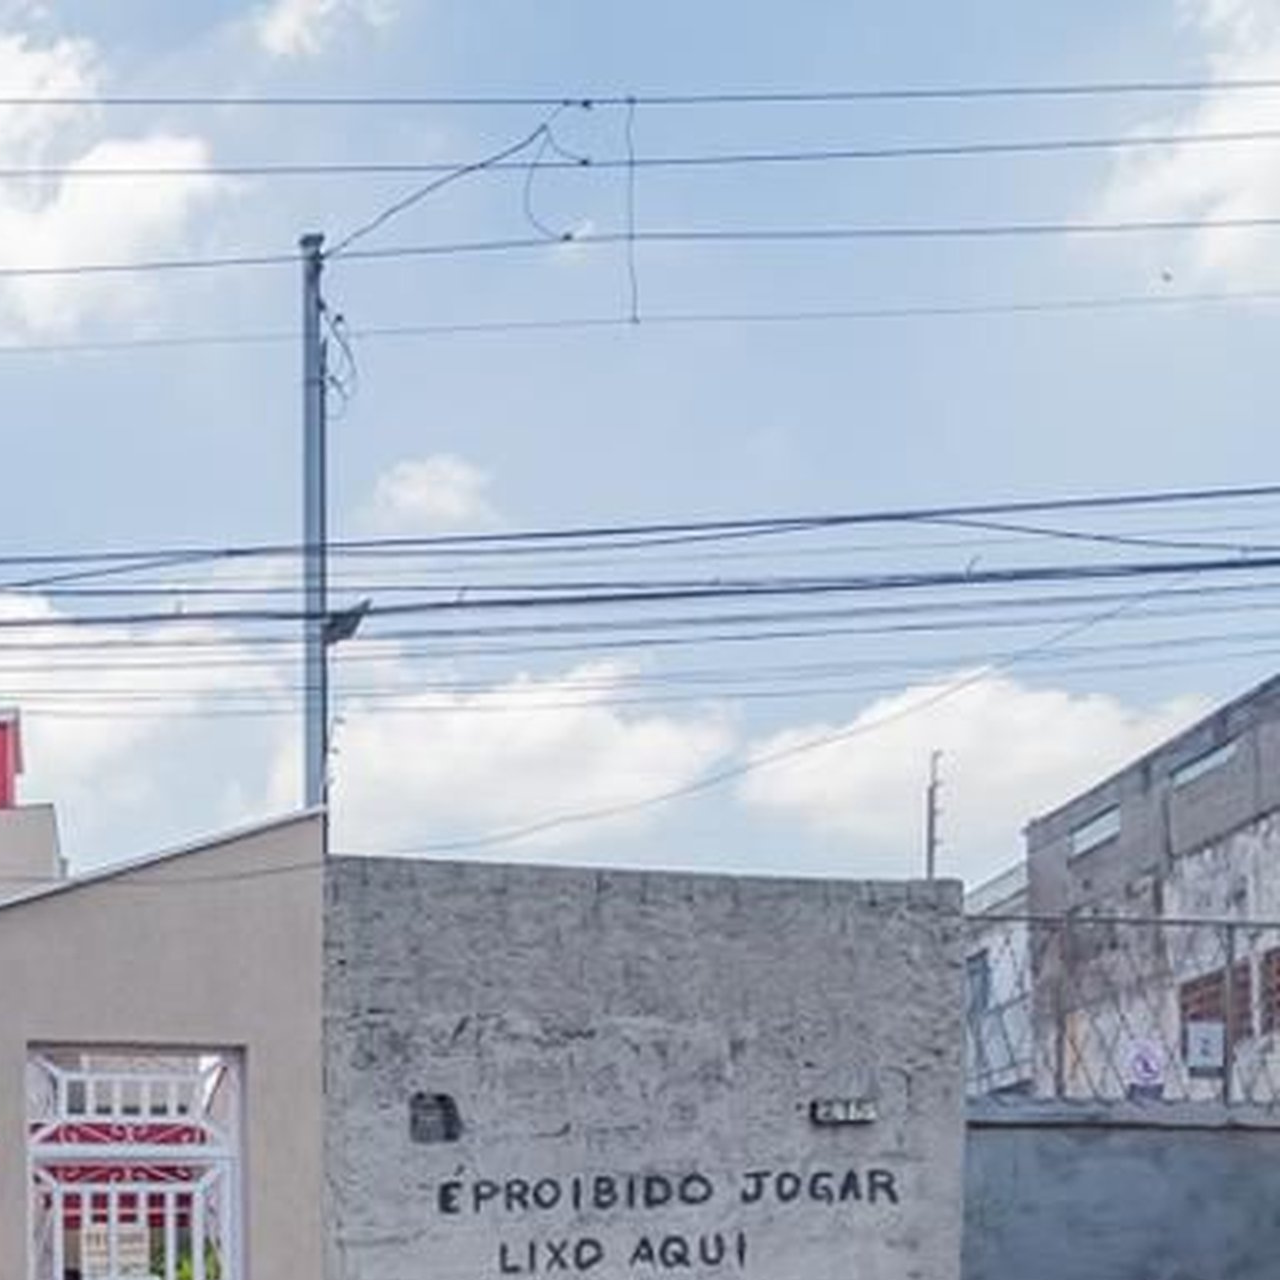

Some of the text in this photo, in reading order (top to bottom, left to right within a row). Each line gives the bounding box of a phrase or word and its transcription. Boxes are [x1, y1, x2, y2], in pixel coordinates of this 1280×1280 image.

[741, 1169, 899, 1205] JOGAR
[500, 1232, 746, 1273] LIXO AQUI
